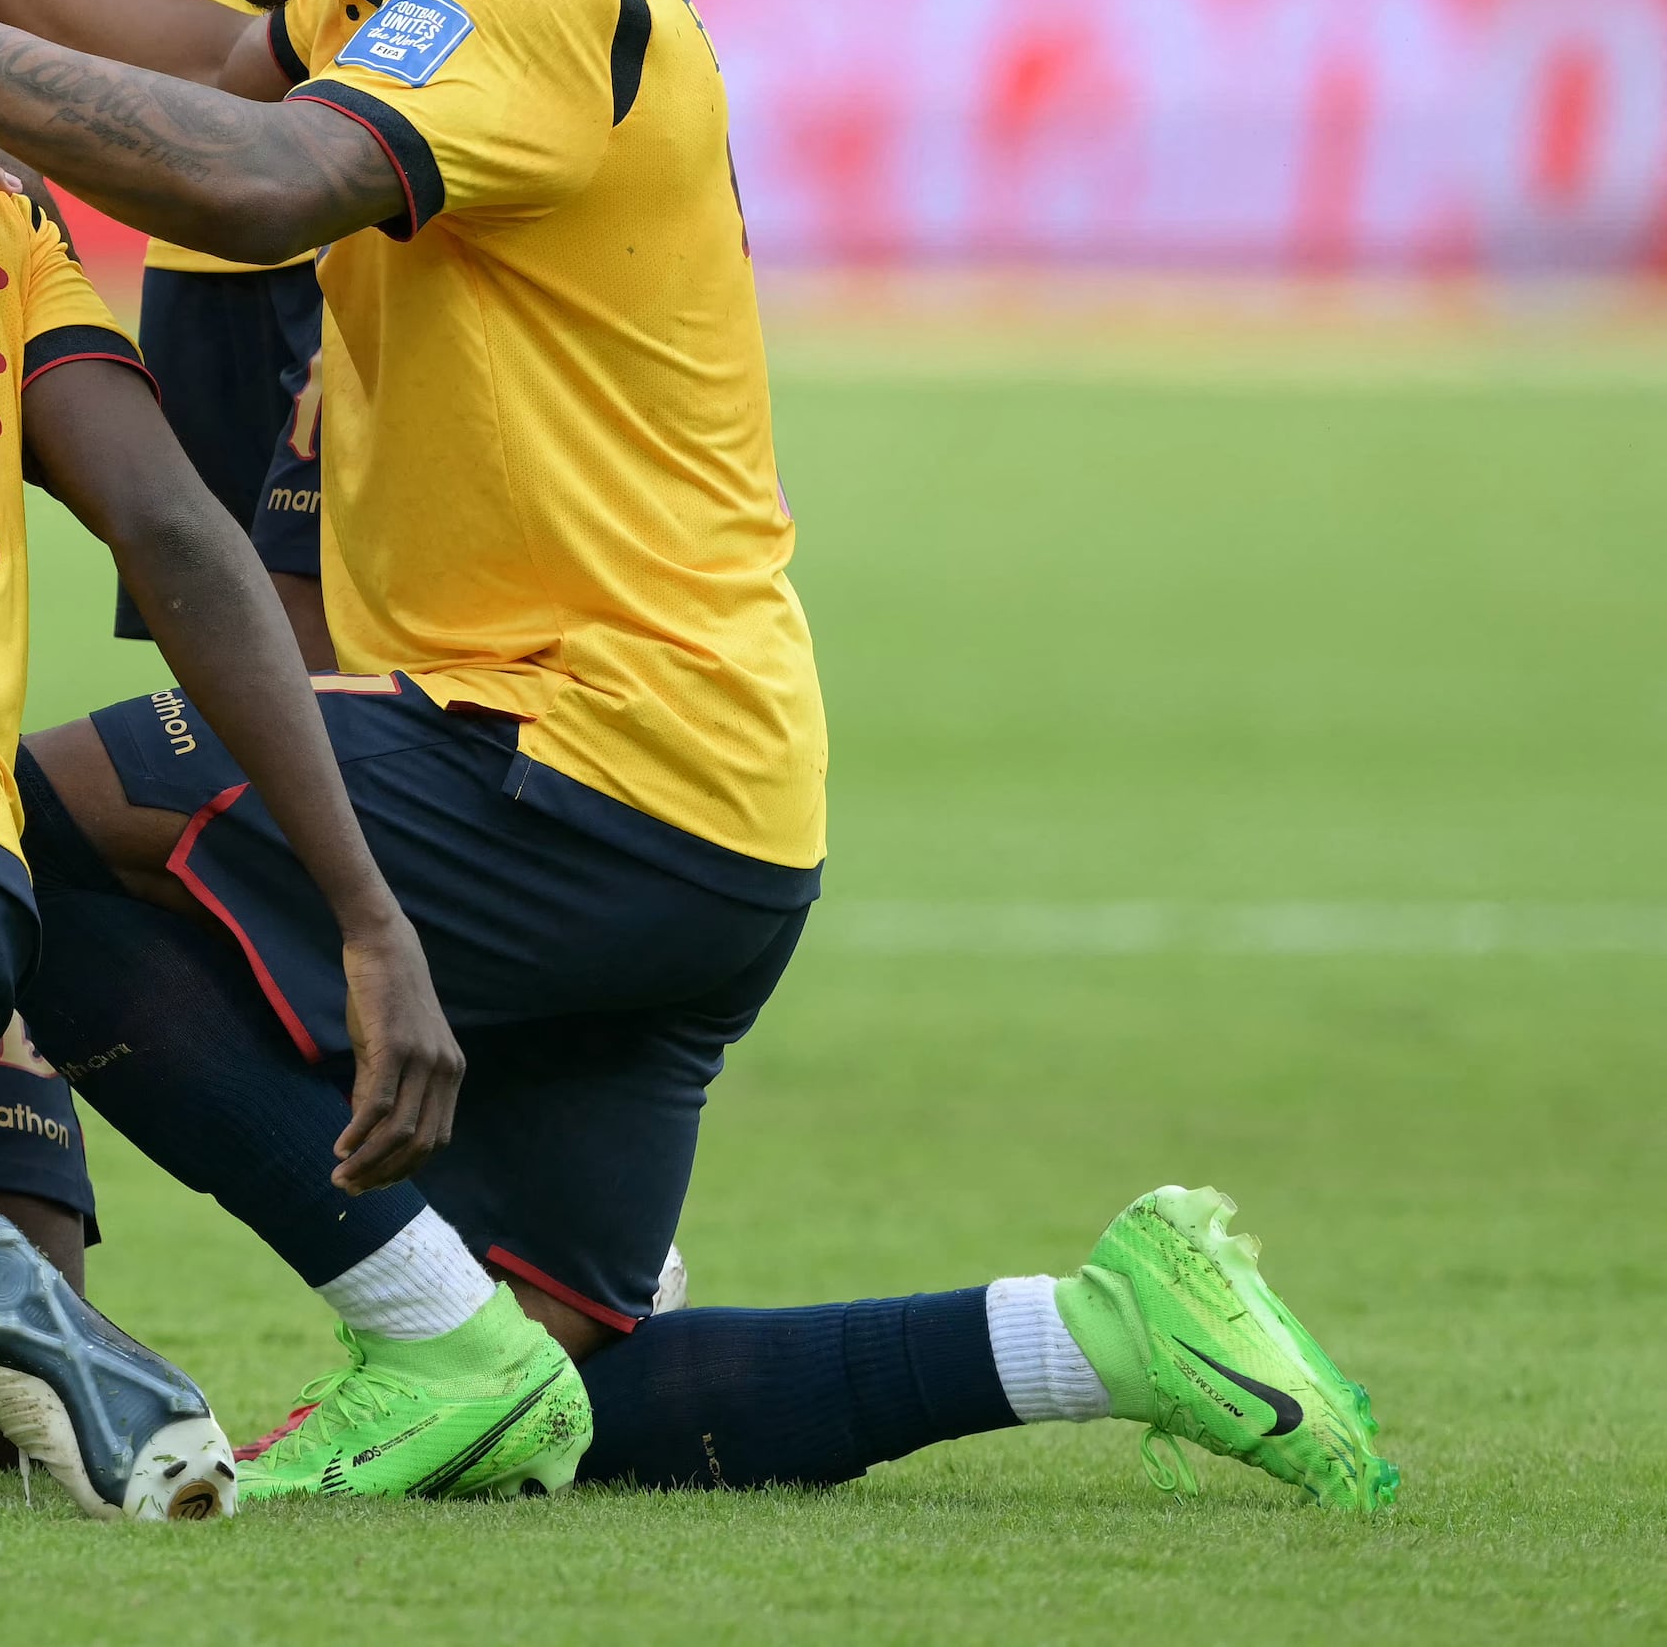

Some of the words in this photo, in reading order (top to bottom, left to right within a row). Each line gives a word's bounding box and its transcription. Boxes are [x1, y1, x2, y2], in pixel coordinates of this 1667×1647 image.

[380, 11, 441, 40] UNITES
[390, 0, 447, 29] FOOTBALL
[367, 26, 390, 40] the
[389, 32, 433, 54] World
[376, 45, 399, 57] FIFA
[151, 688, 198, 756] athon
